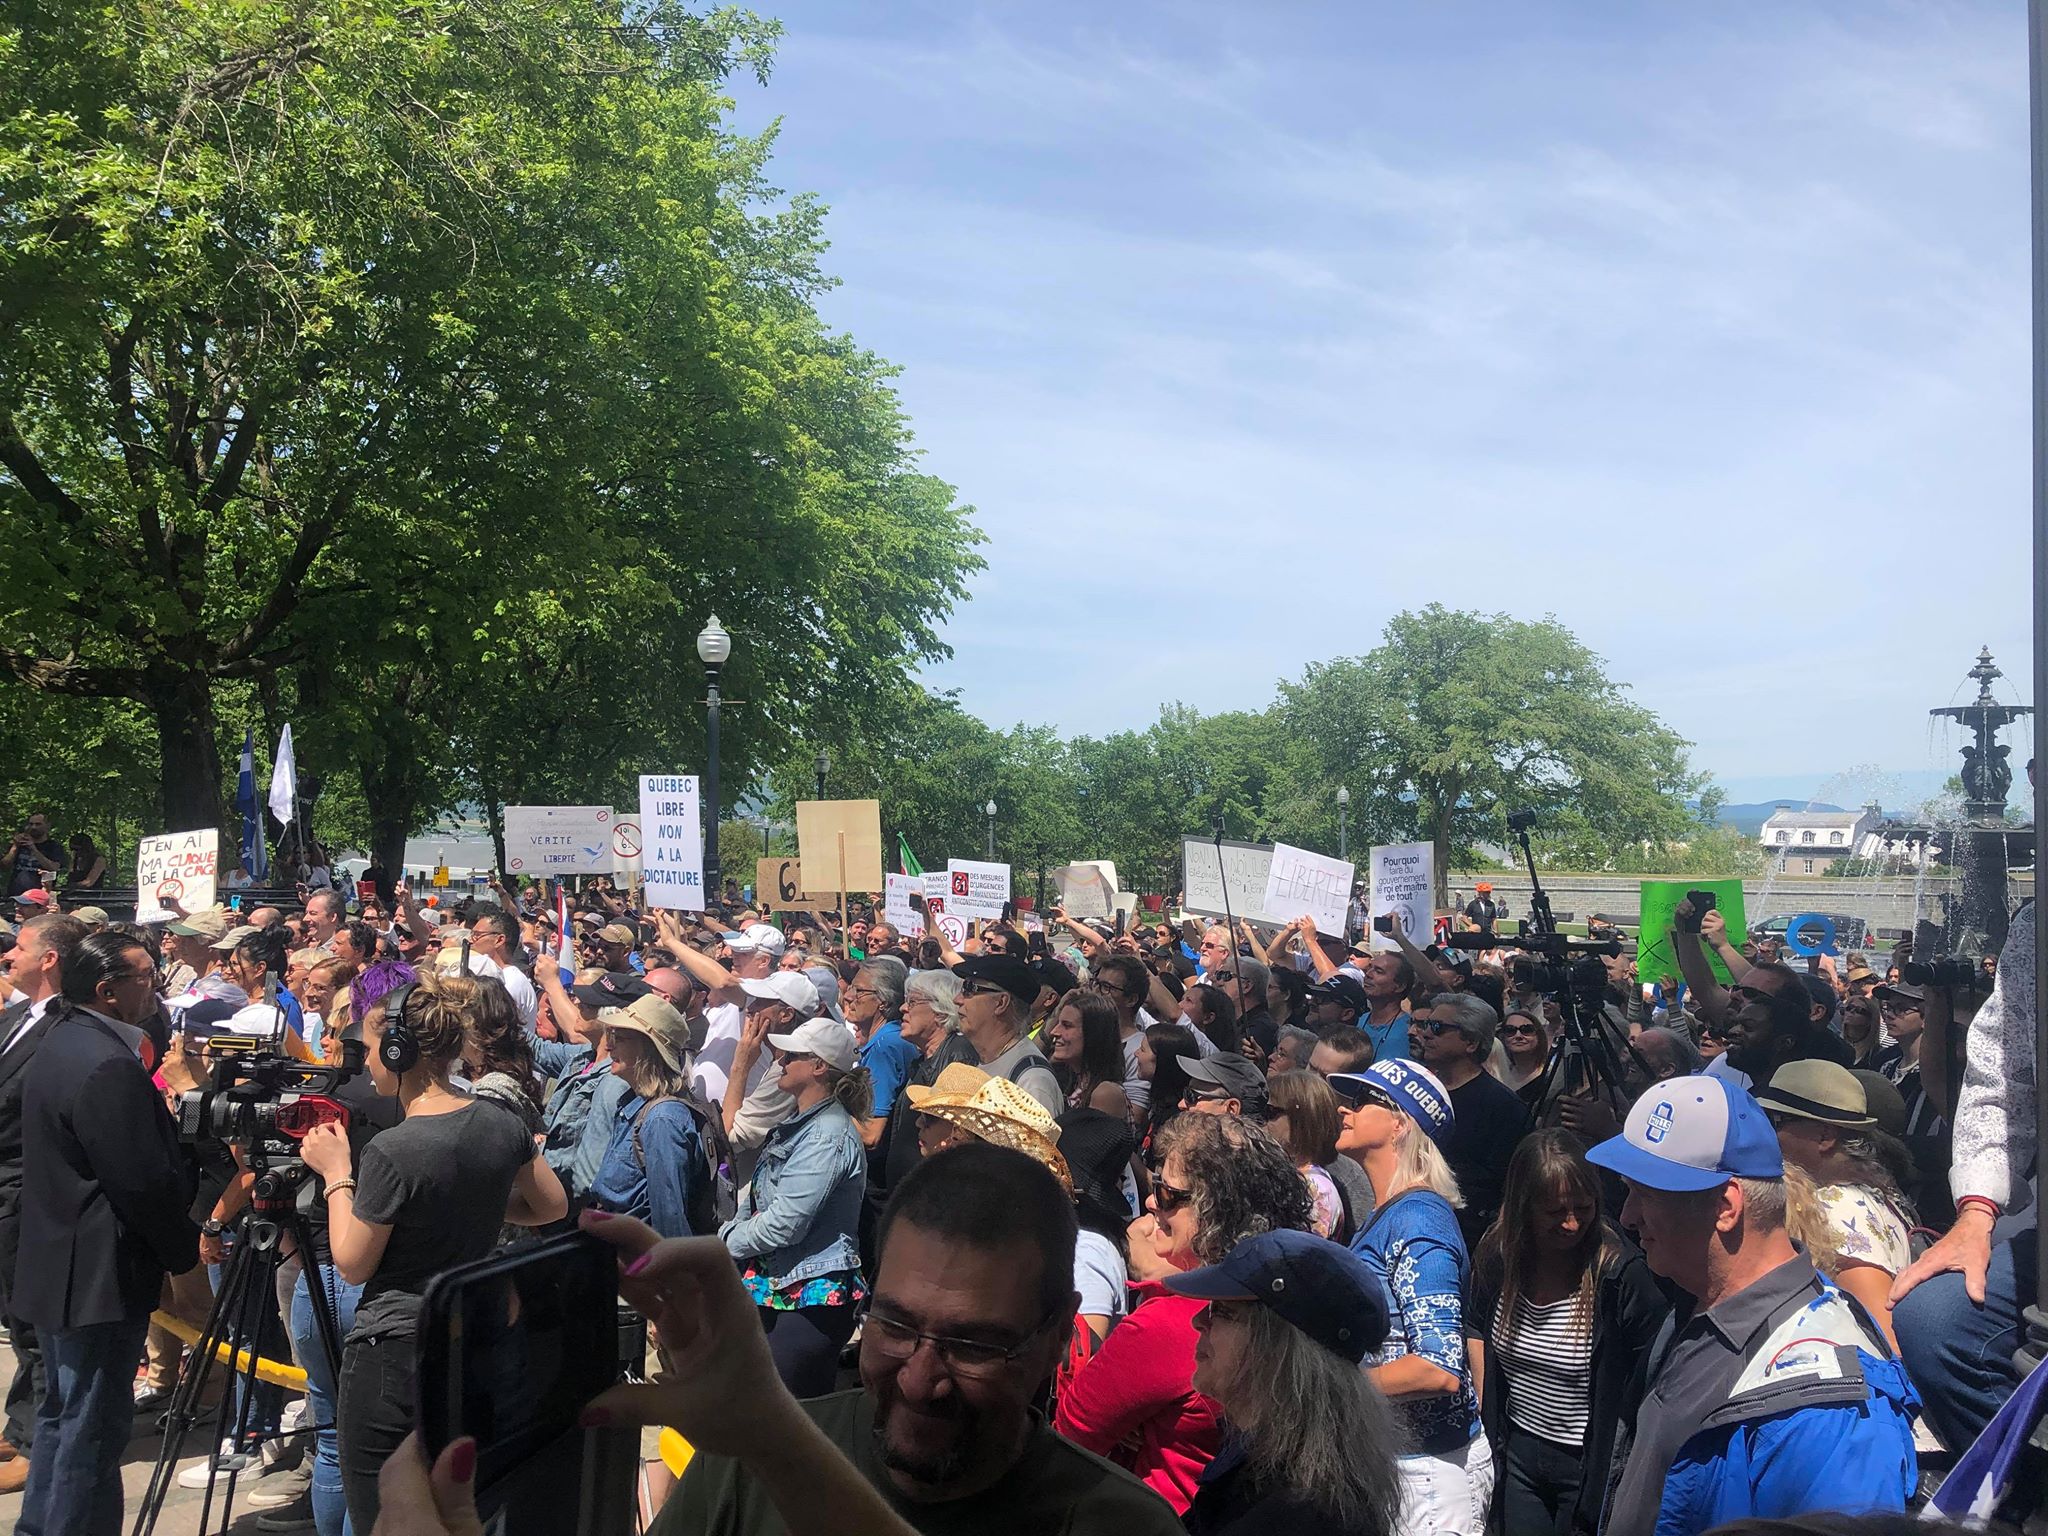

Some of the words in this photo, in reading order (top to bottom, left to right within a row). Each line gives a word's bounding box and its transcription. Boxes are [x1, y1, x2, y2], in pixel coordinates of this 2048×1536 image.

[656, 801, 685, 816] LIBRE
[658, 824, 682, 840] NON
[140, 857, 162, 873] MA
[167, 850, 218, 867] CLAQUE
[669, 848, 682, 862] LA
[1383, 854, 1420, 867] Pourquoi
[142, 871, 157, 886] DE
[163, 868, 179, 881] LA
[970, 872, 980, 880] DES
[980, 873, 1005, 882] MESURES
[1389, 867, 1403, 875] faire
[1404, 866, 1414, 874] du
[970, 881, 1005, 891] D'URGENCES
[1378, 873, 1426, 887] gouvernement
[1383, 885, 1394, 894] roi
[1395, 884, 1402, 893] et
[1403, 882, 1428, 892] maître
[1385, 893, 1395, 901] de
[1396, 892, 1413, 901] tout
[1404, 1080, 1447, 1126] QUEBEC
